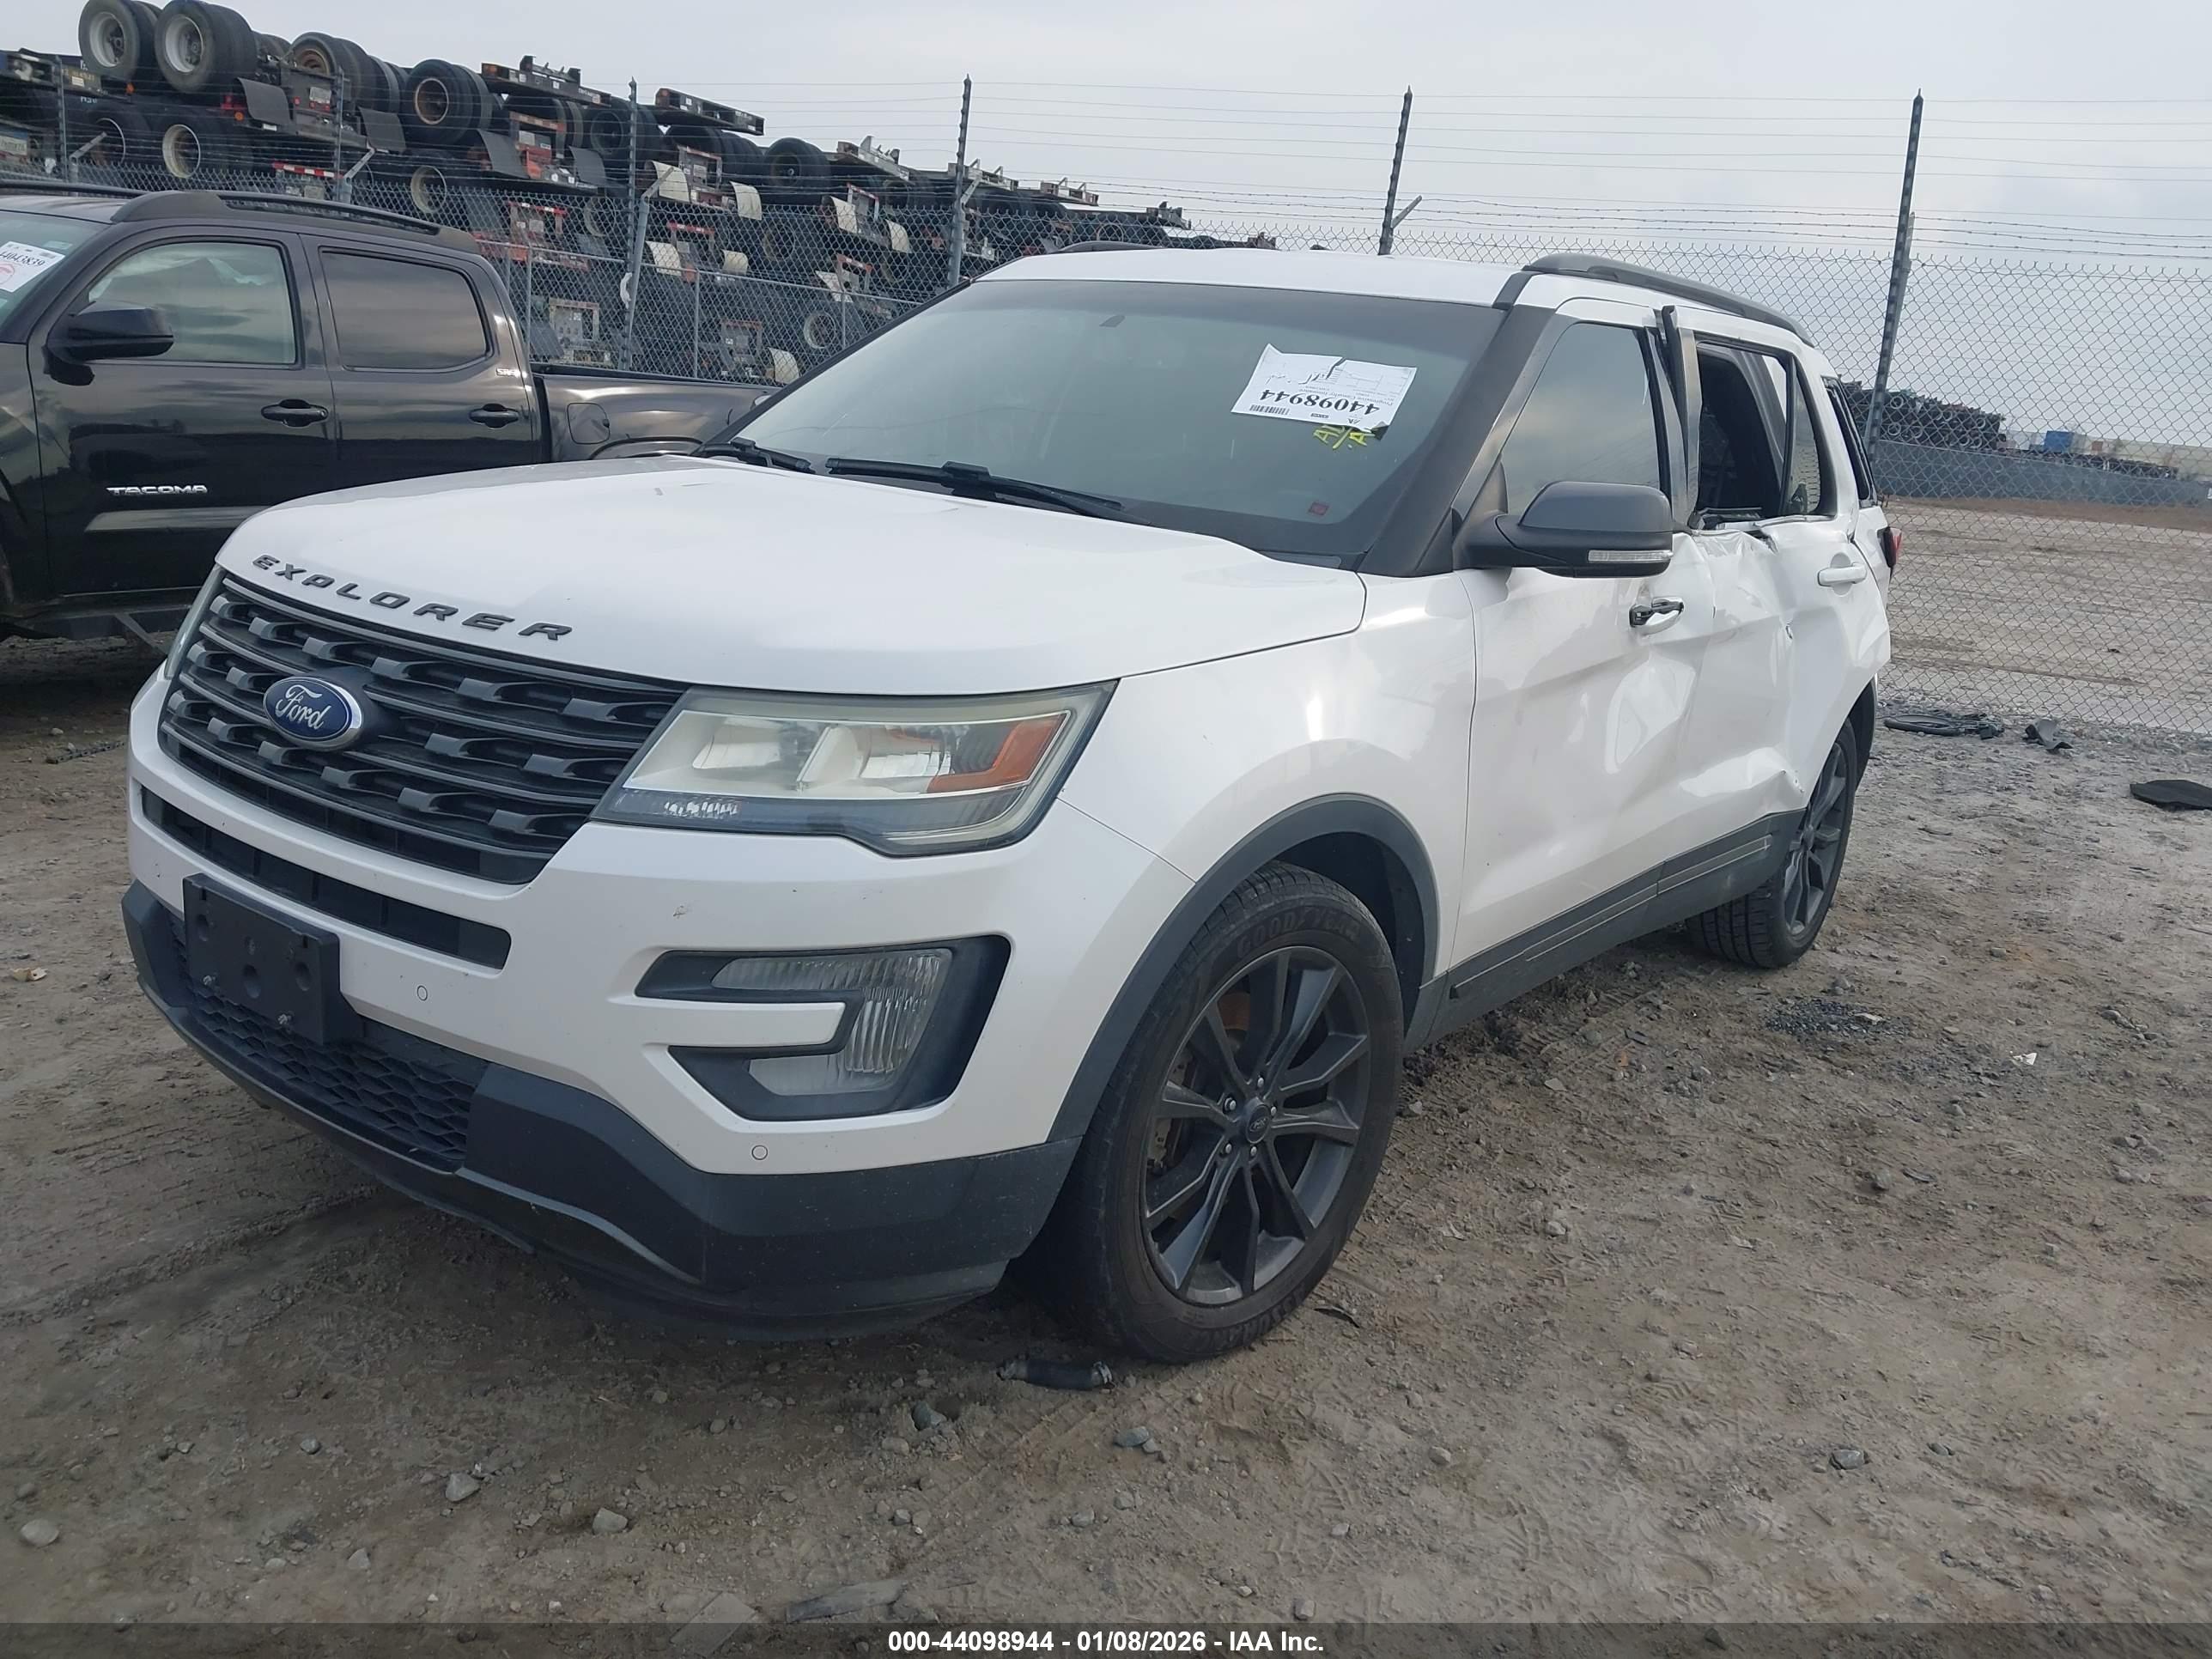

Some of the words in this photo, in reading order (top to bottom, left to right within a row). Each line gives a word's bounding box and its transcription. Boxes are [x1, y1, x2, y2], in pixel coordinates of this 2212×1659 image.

[1259, 390, 1381, 416] 44098944
[106, 484, 209, 496] TACOMA
[252, 554, 573, 641] EXPLORER
[274, 684, 332, 731] Ford
